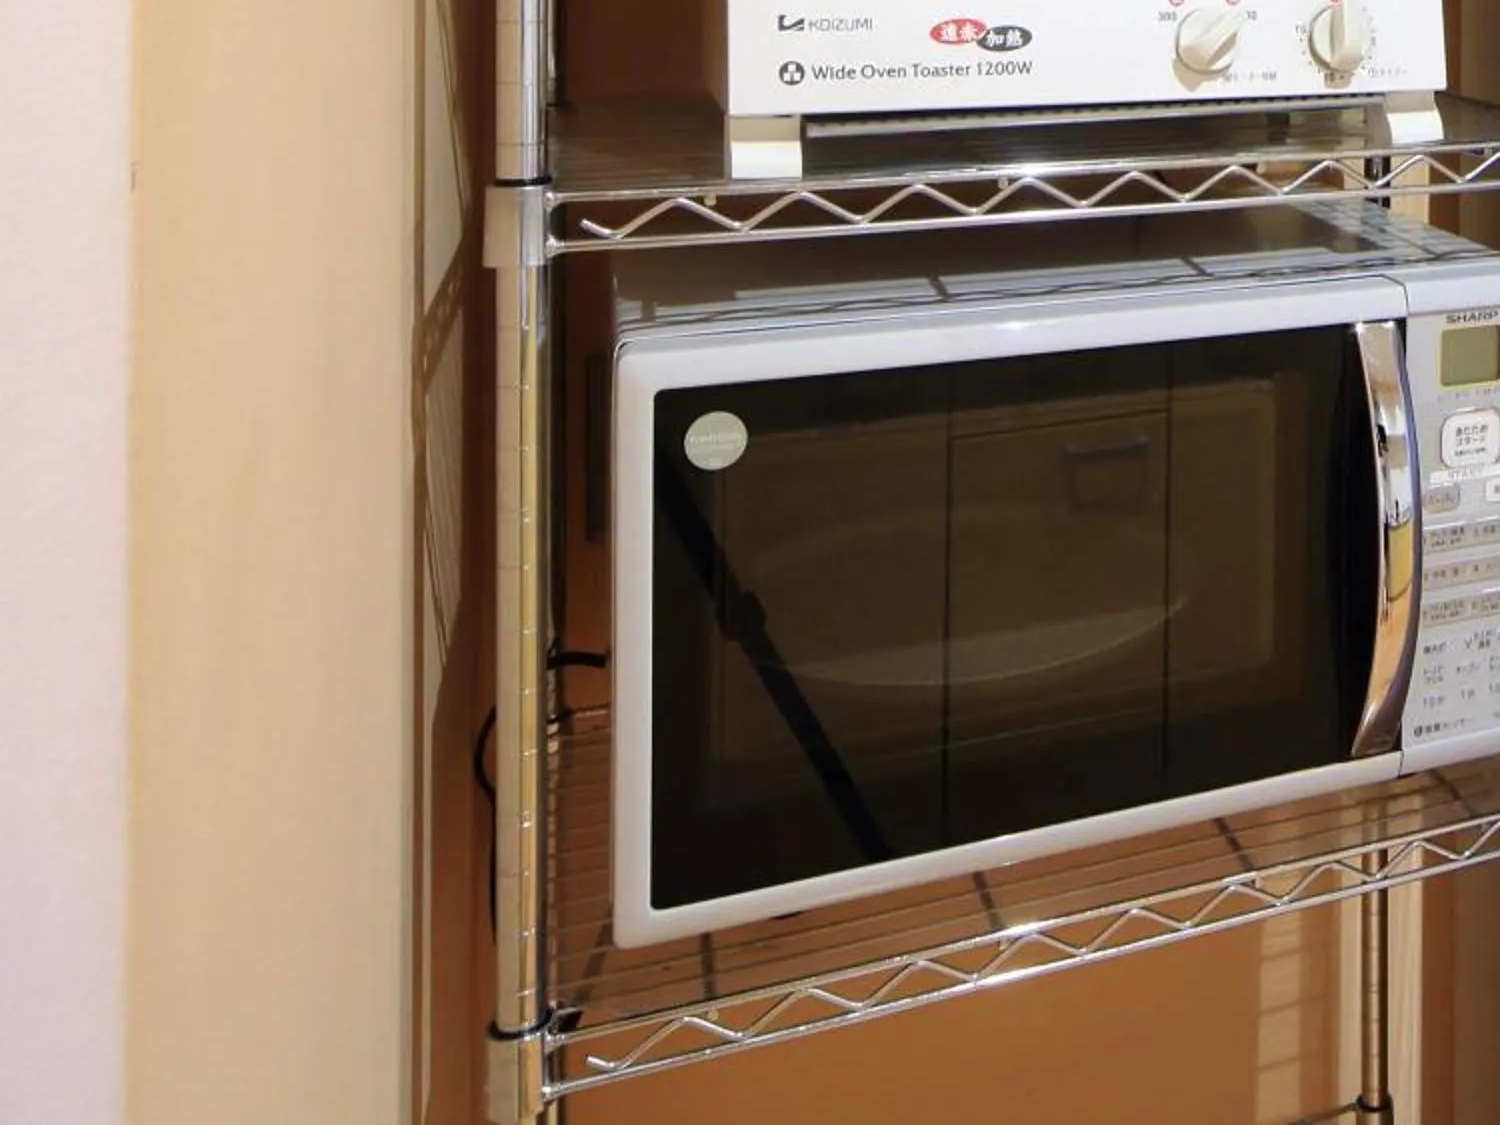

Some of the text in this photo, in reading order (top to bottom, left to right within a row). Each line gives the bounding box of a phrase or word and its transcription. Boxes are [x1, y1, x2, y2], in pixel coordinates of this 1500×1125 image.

[808, 17, 874, 32] KOIZUMI
[811, 60, 1034, 81] Wide Oven Toaster 1200W
[1445, 310, 1499, 324] SHARP
